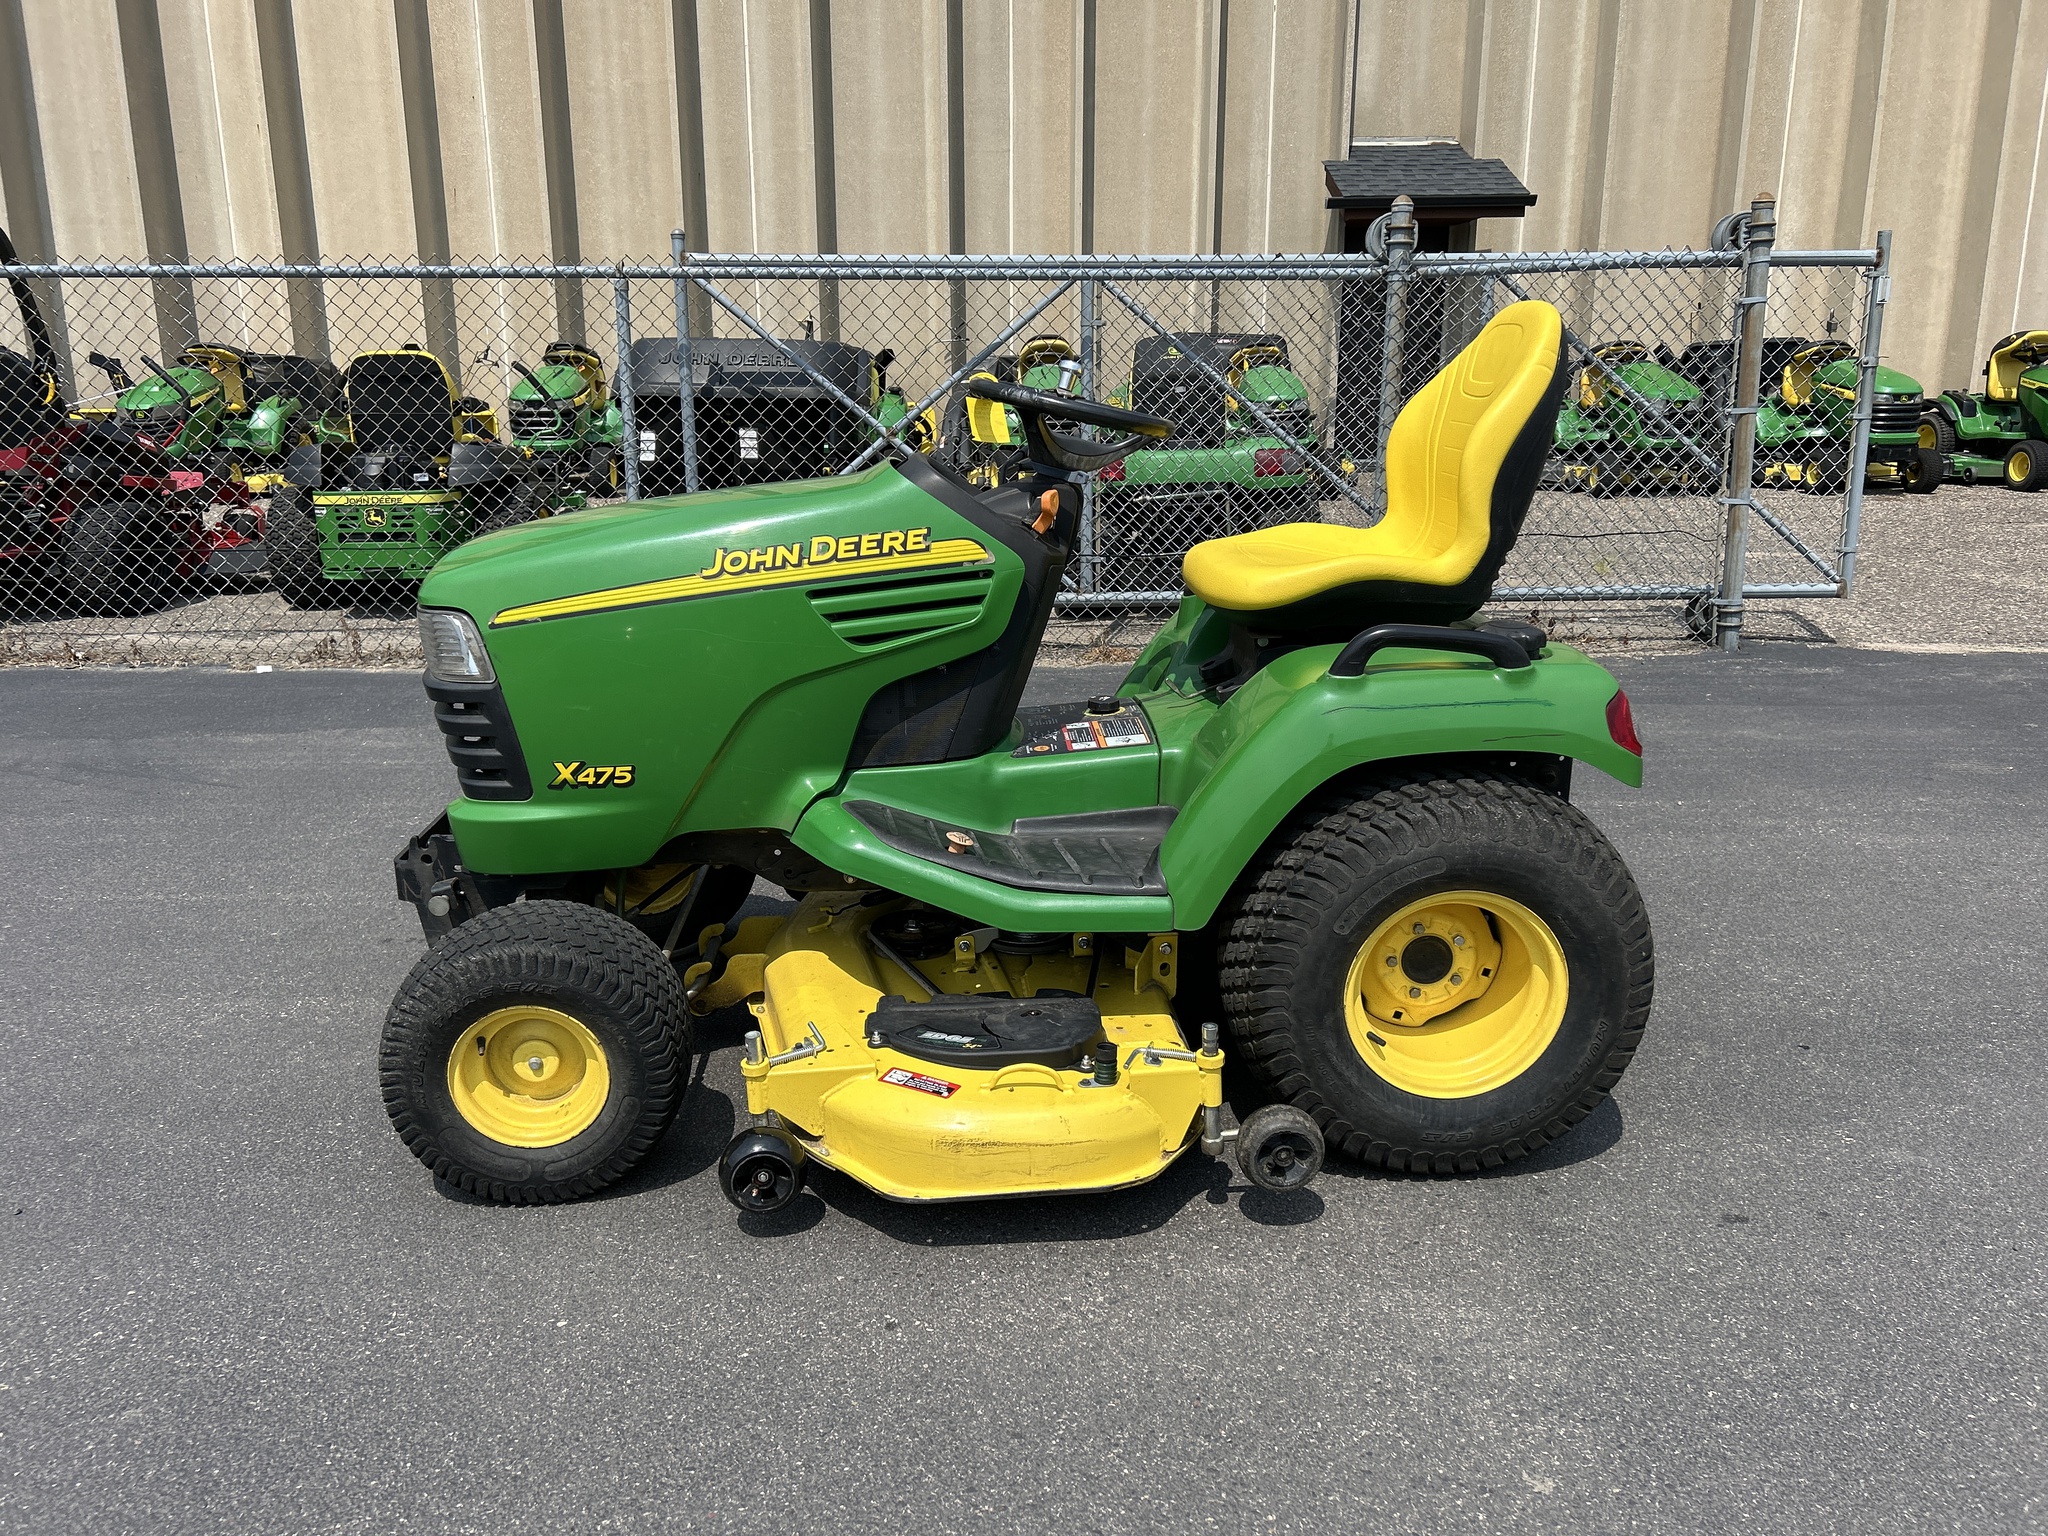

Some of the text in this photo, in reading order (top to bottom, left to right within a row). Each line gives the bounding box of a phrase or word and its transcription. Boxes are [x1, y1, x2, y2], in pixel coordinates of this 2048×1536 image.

[344, 496, 403, 505] JOHN DEERE
[702, 527, 931, 578] JOHN DEERE
[547, 761, 636, 790] X475
[1563, 1019, 1609, 1094] MULTI
[1490, 1095, 1557, 1138] TRAC
